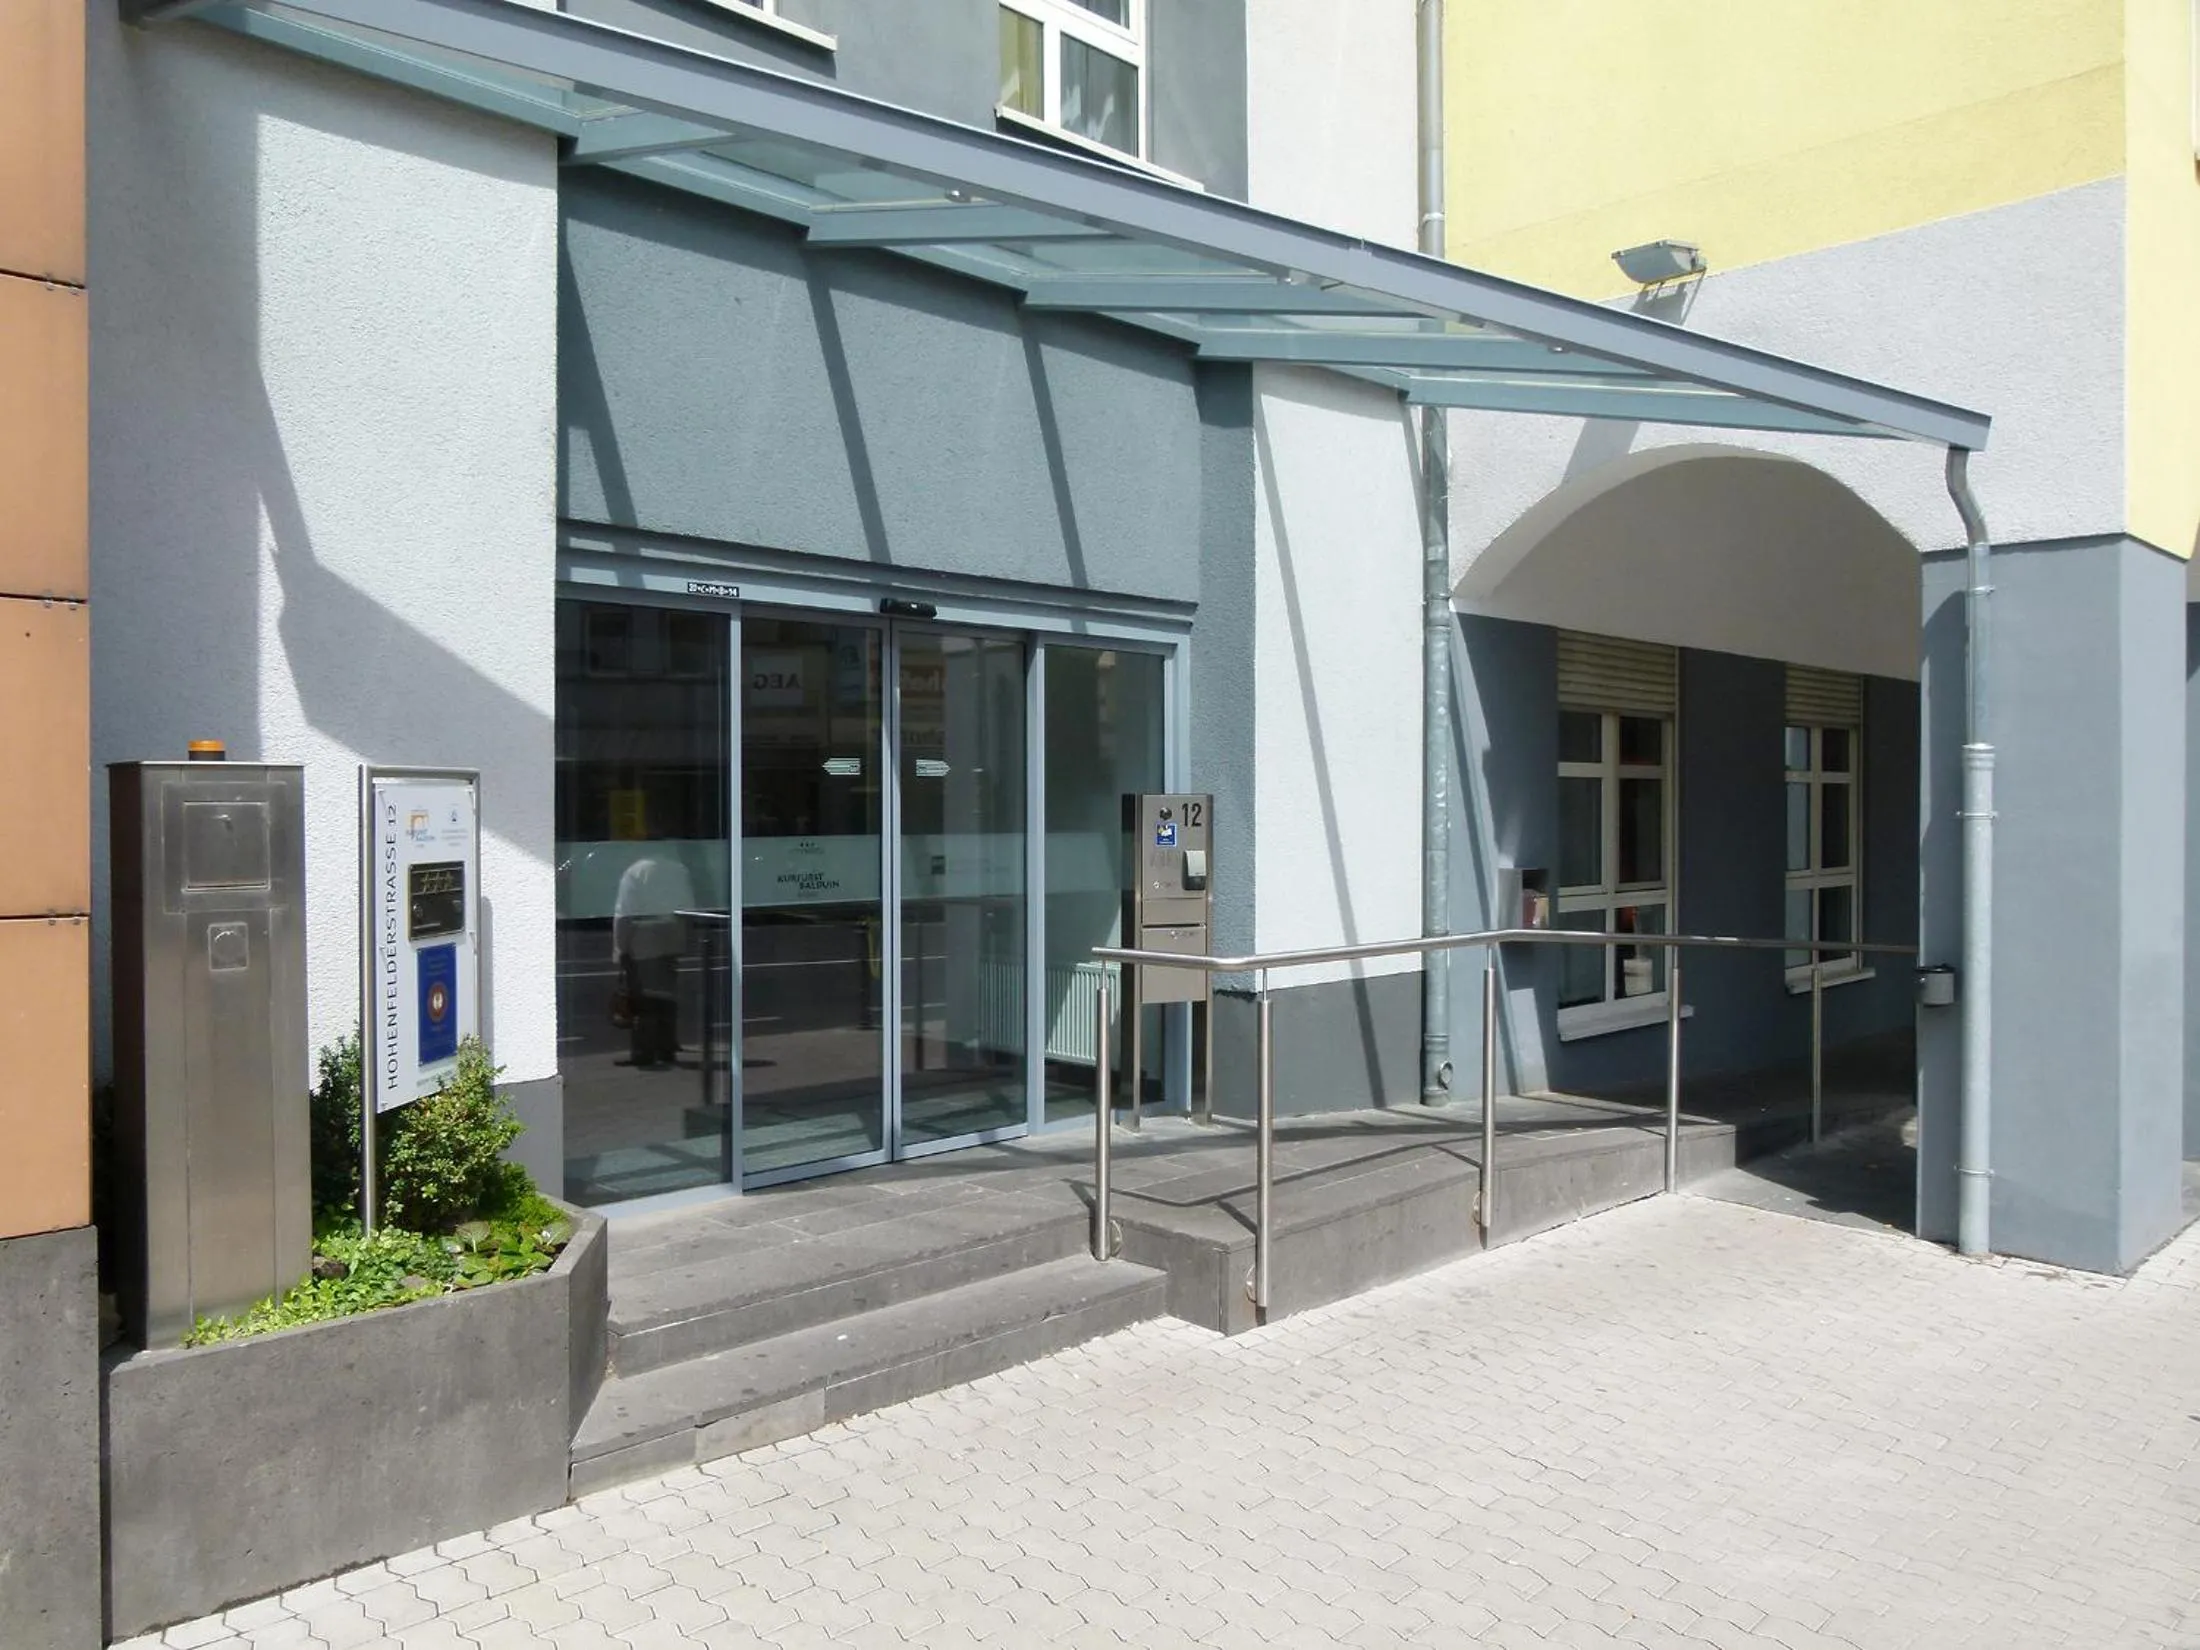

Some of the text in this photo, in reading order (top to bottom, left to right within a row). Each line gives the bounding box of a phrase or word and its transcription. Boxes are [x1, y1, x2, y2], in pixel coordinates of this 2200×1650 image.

[1182, 803, 1202, 828] 12
[385, 804, 399, 1091] HOHENFELDERSTRASSE 12
